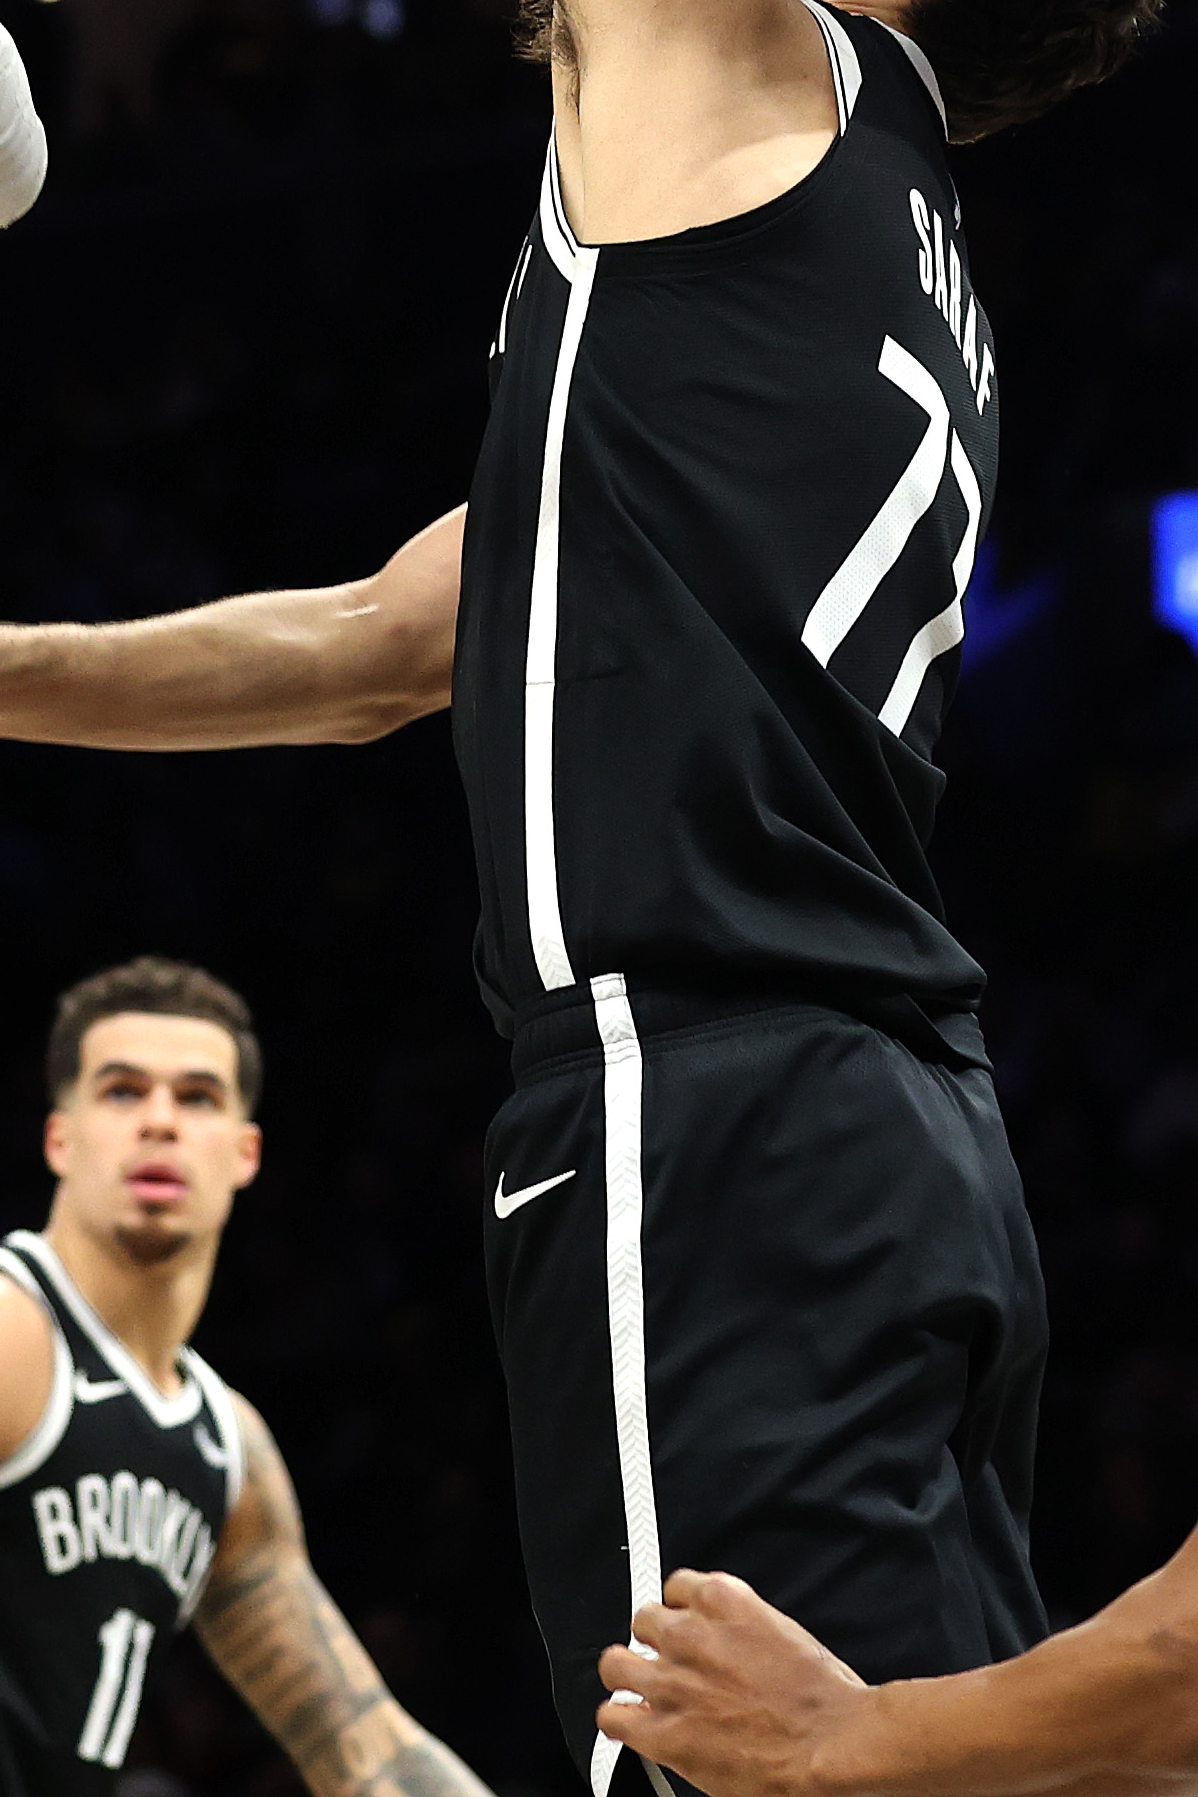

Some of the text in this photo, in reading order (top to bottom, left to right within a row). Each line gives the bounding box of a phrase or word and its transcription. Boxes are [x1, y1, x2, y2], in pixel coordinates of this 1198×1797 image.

[909, 188, 995, 416] SARAF
[801, 333, 983, 739] 77
[77, 1607, 155, 1770] 11
